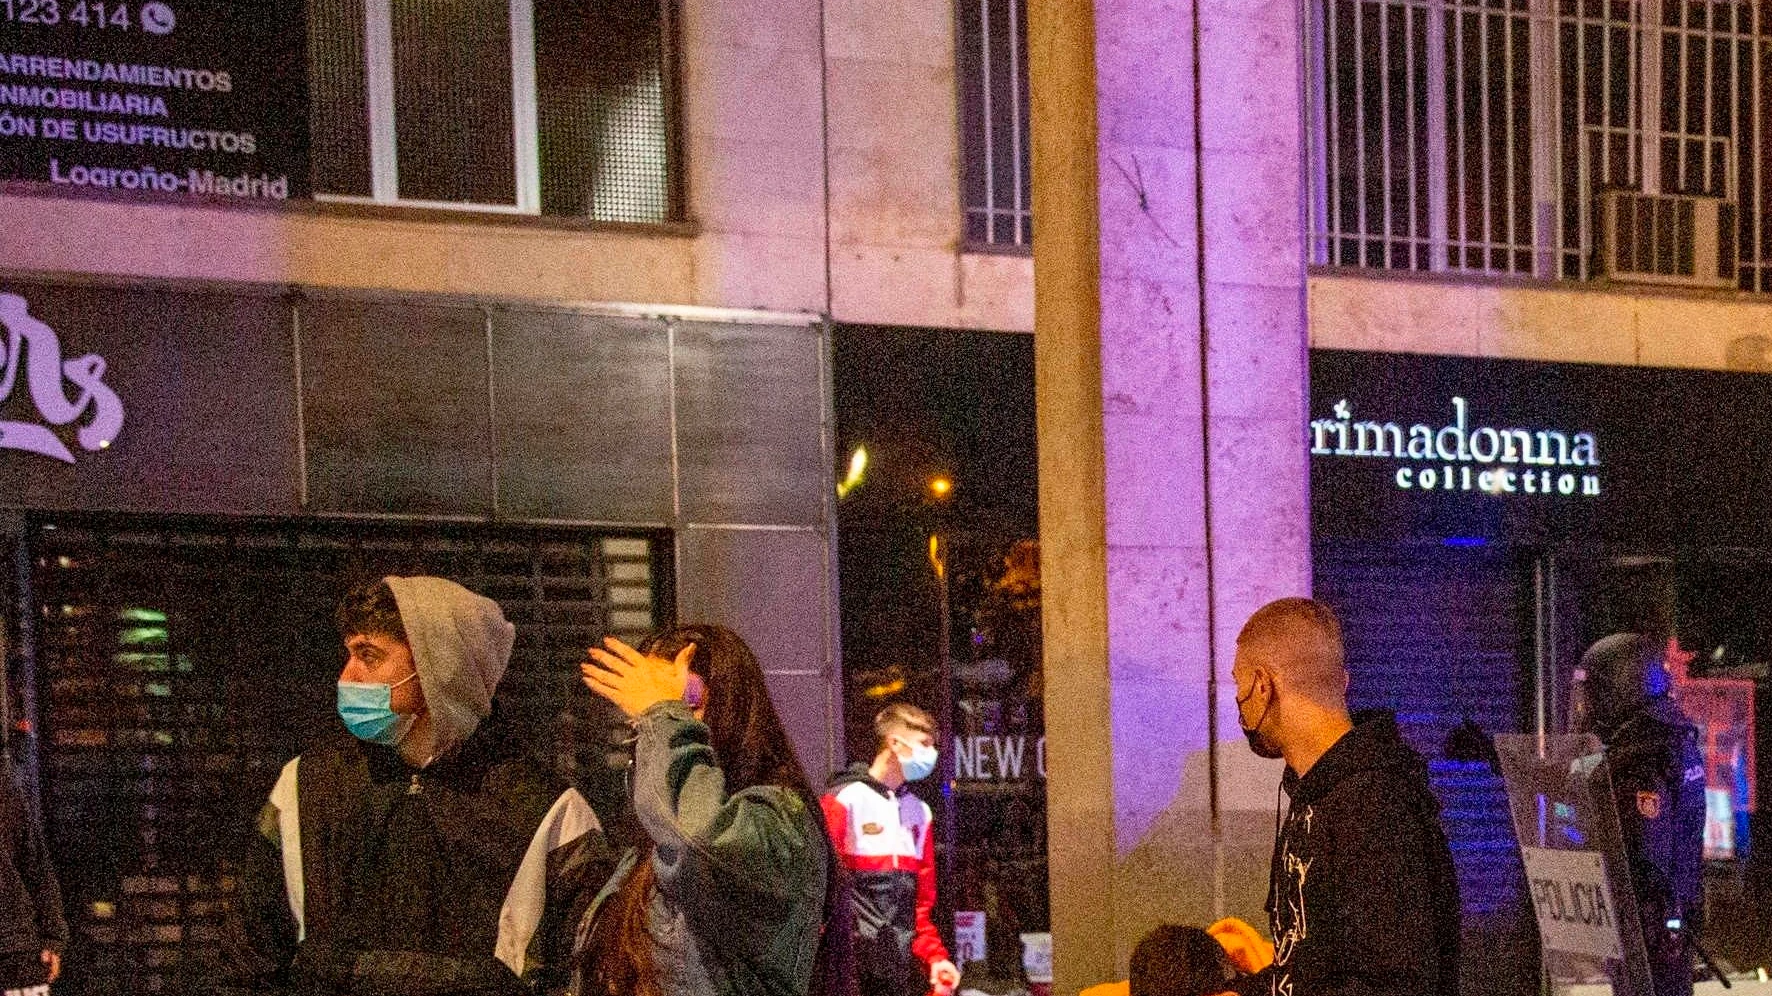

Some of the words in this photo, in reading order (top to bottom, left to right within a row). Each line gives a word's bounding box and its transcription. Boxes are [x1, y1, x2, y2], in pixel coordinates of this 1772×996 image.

[3, 0, 60, 25] 123
[69, 0, 129, 31] 414
[0, 53, 232, 92] ARRENDAMIENTOS
[42, 118, 77, 140] DE
[83, 119, 256, 154] USUFRUCTOS
[1395, 466, 1601, 495] collection
[954, 734, 1026, 779] NEW
[1532, 877, 1613, 929] POLICIA
